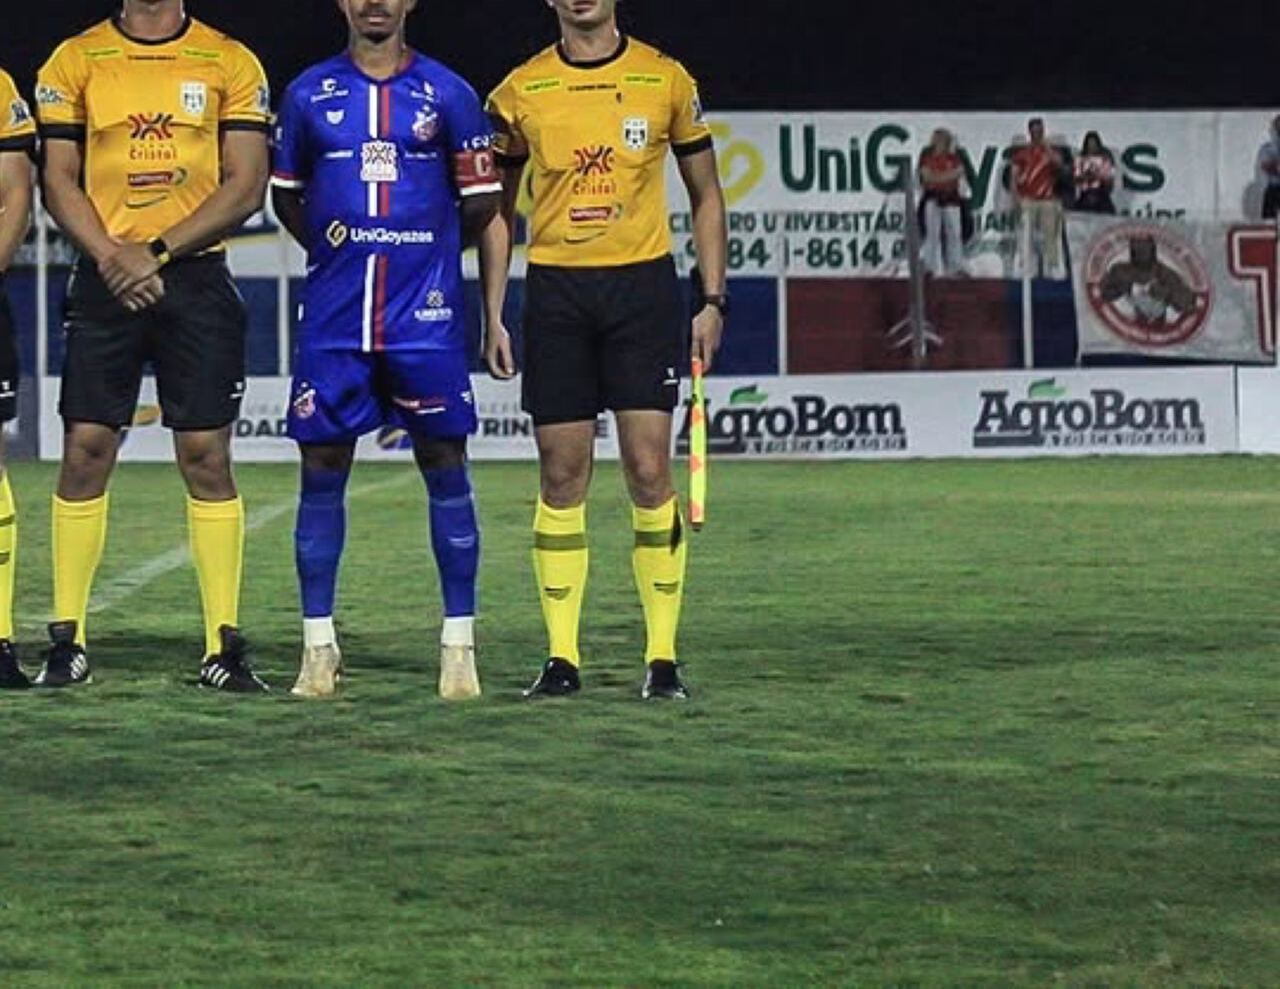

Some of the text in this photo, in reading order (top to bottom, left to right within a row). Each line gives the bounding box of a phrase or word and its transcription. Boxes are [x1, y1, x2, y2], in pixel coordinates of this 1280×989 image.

[476, 153, 492, 177] C
[350, 228, 434, 245] UniGoyazes
[675, 395, 905, 453] AgroBom
[973, 388, 1205, 448] AgroBom
